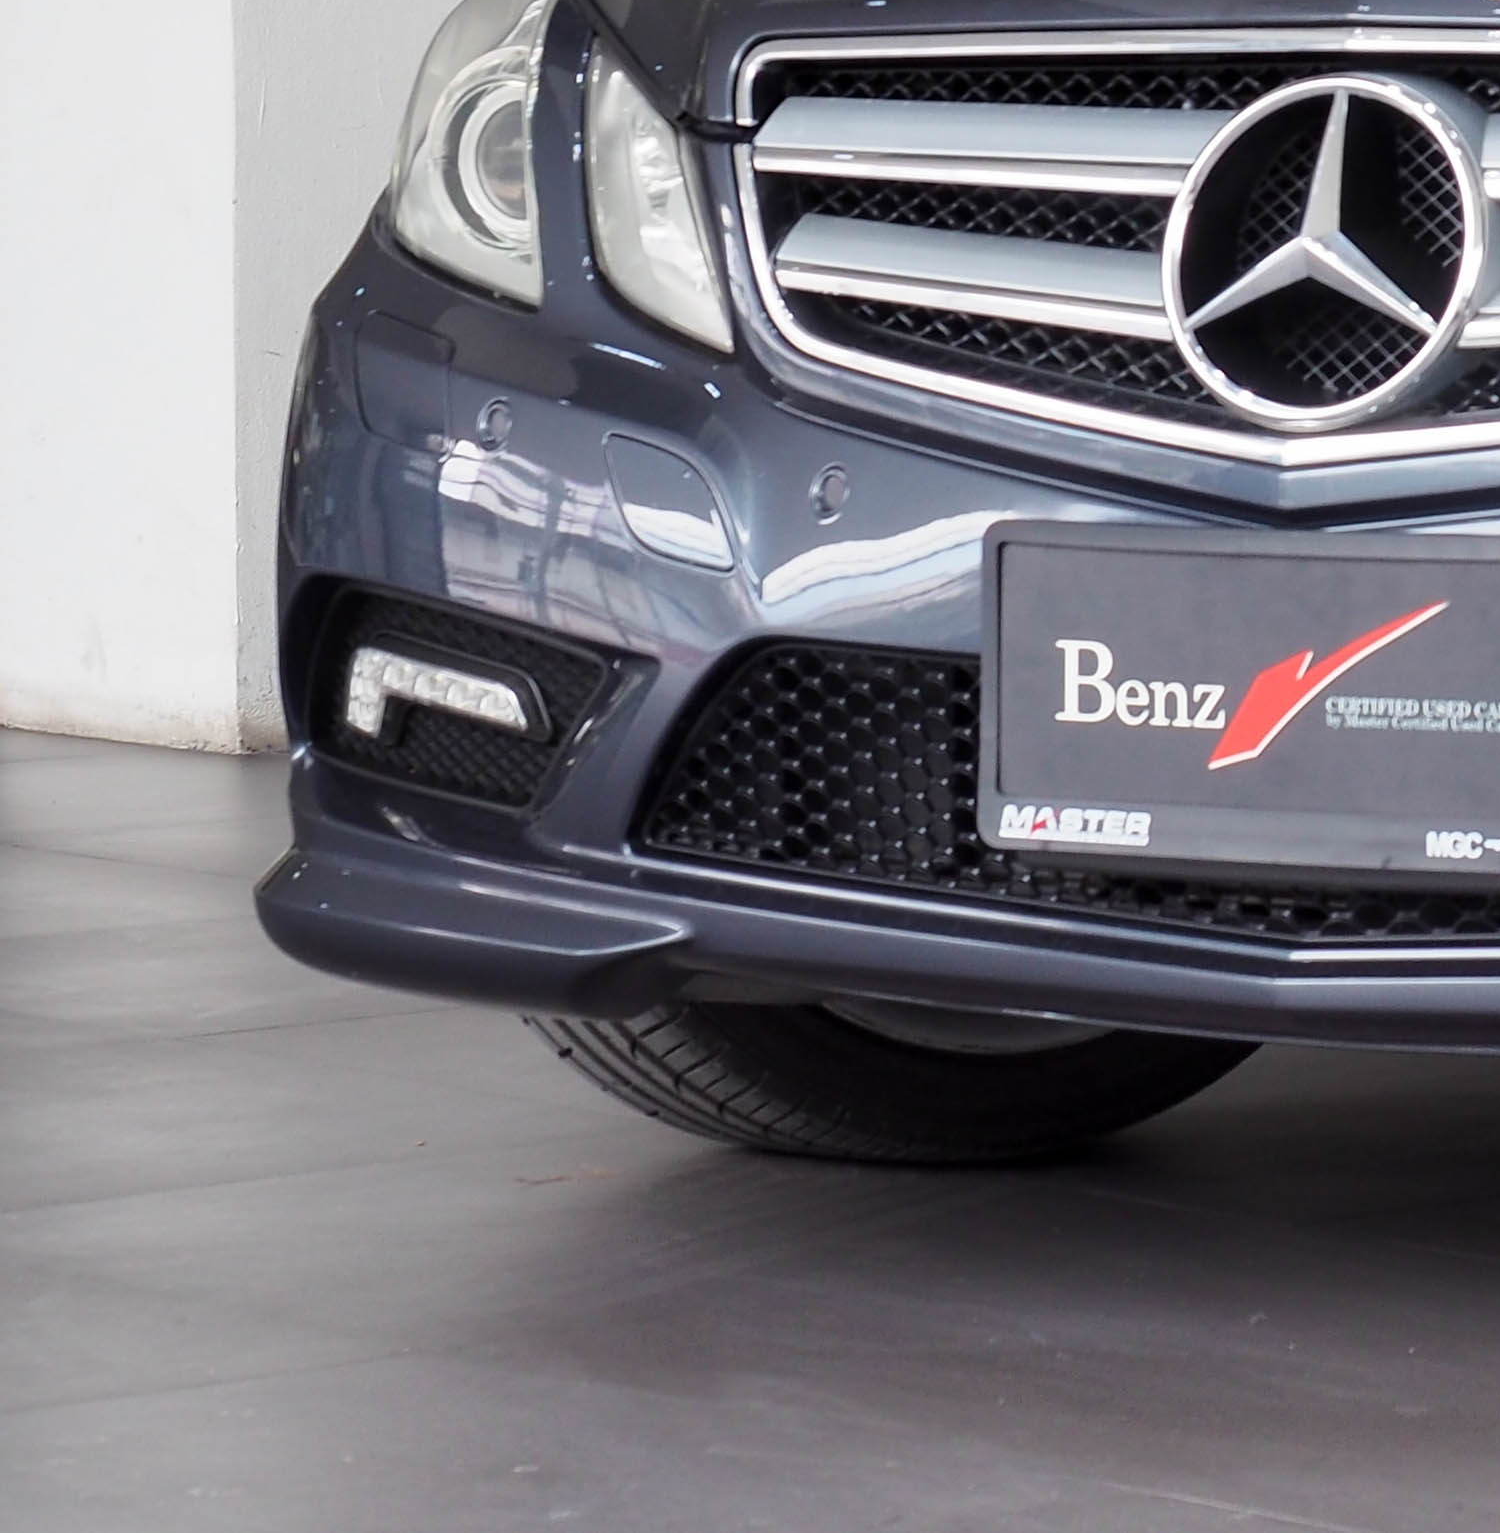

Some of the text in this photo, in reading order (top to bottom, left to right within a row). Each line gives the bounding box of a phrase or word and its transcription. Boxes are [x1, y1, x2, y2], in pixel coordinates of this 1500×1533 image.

[1054, 639, 1226, 730] Benz
[1325, 696, 1420, 717] CERTIFIED
[1422, 699, 1472, 717] USED
[1000, 804, 1151, 842] MASTER
